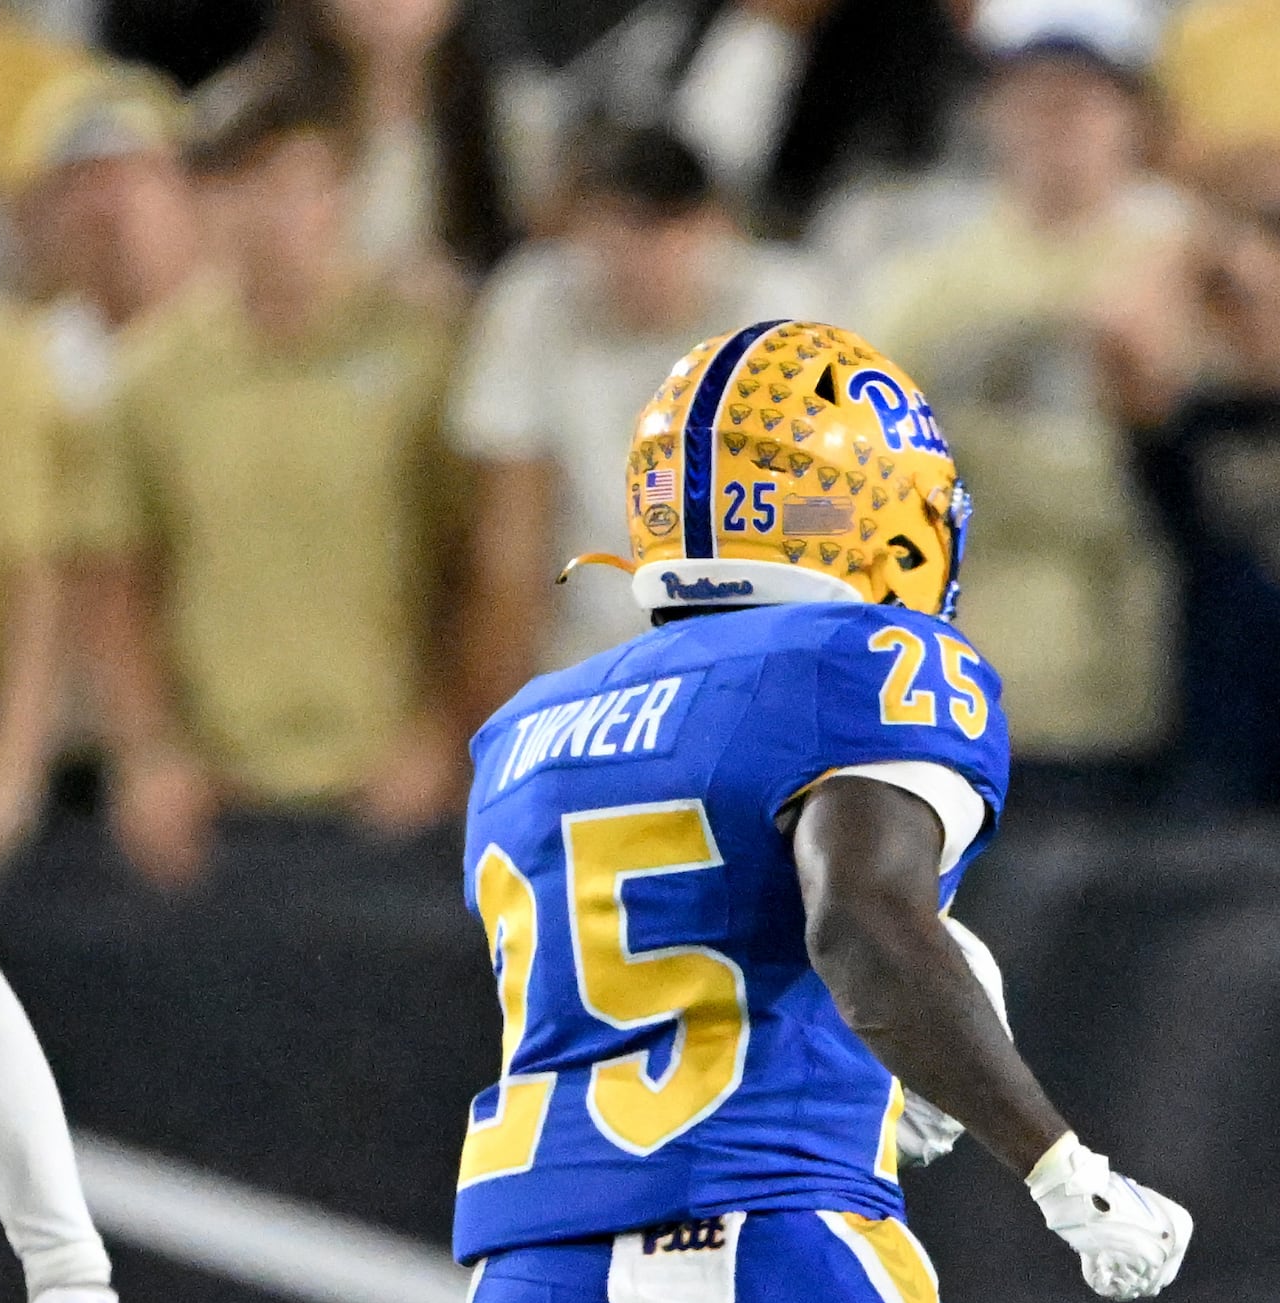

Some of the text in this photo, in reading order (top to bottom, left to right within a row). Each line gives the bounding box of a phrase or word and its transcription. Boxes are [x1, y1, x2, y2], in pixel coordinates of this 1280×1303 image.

[723, 481, 777, 534] 25
[496, 676, 683, 792] TURNER
[868, 625, 989, 740] 25
[456, 799, 750, 1192] 25
